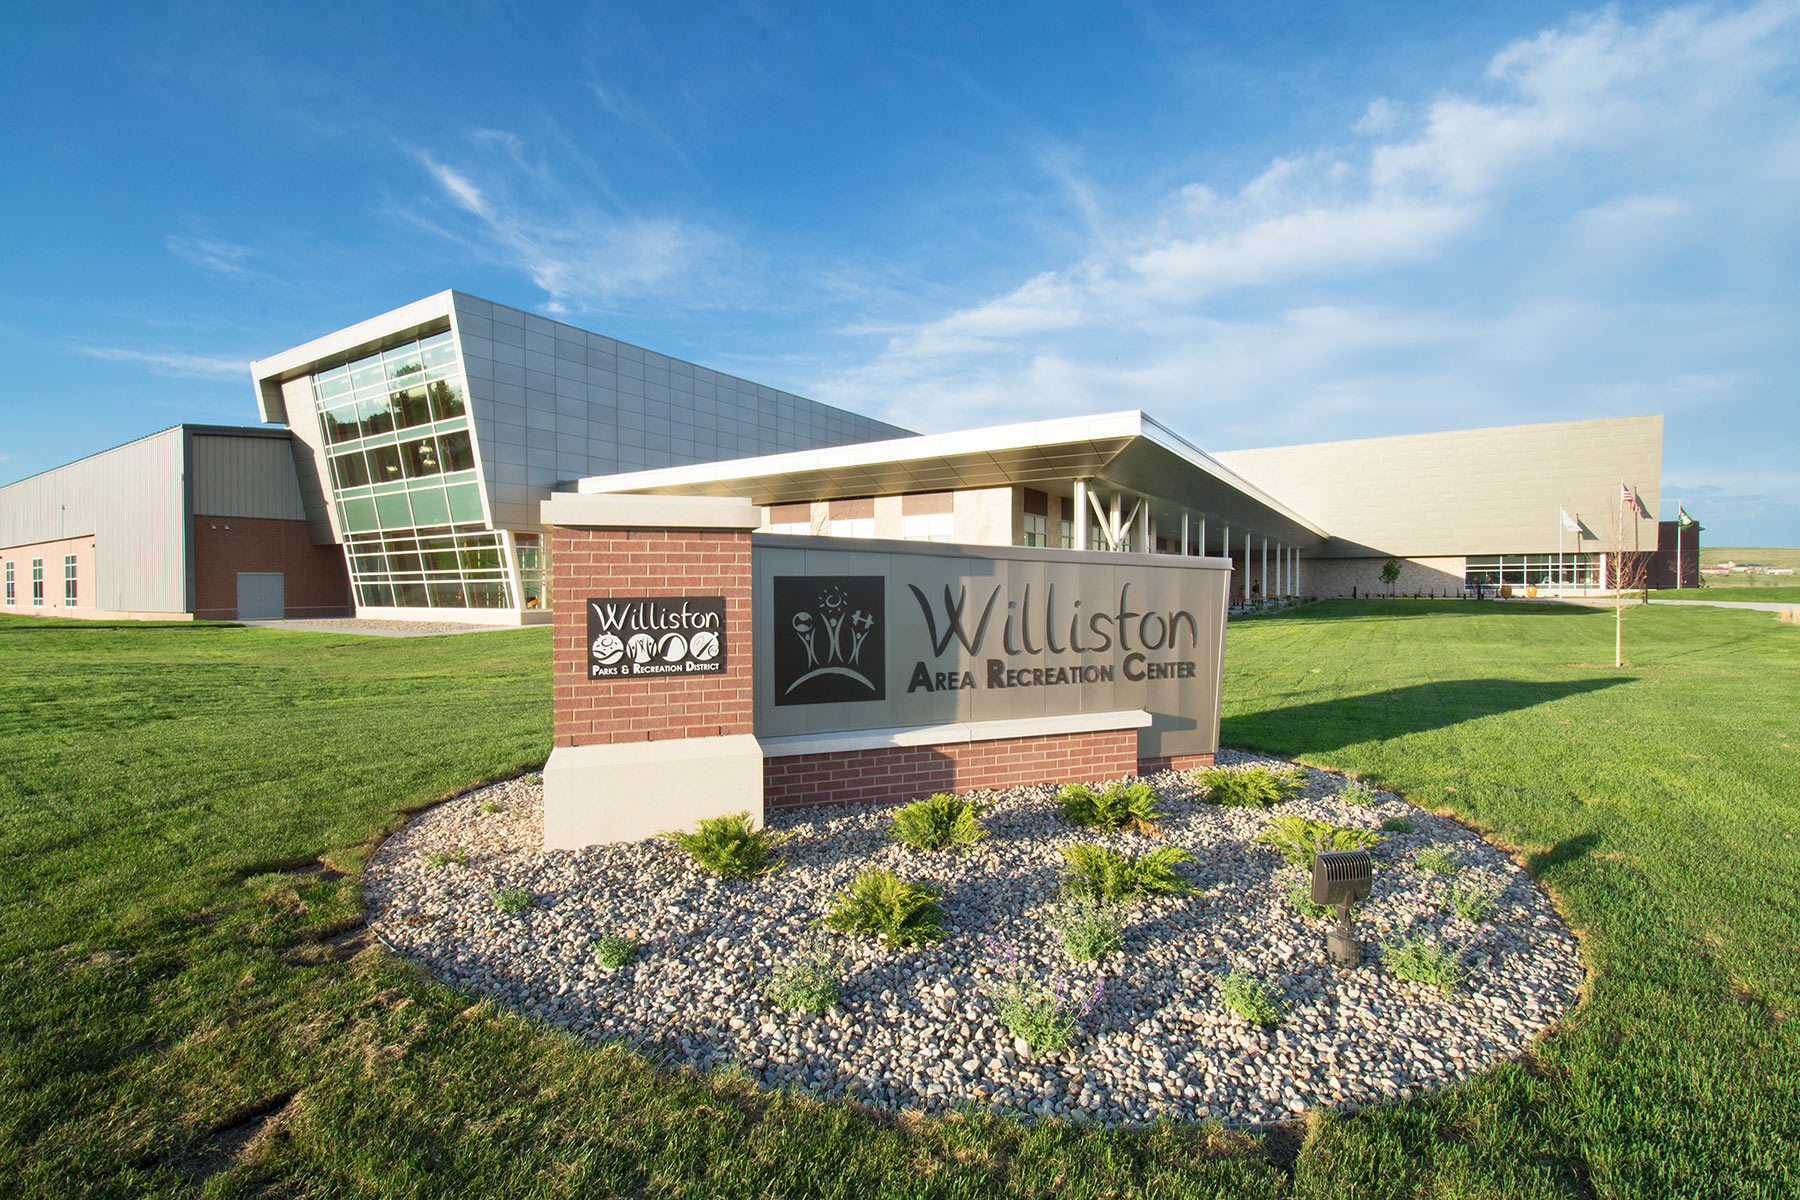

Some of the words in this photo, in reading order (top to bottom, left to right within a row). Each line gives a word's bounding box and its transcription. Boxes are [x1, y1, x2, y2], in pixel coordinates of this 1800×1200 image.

[592, 601, 720, 631] Williston
[908, 582, 1198, 657] Williston
[592, 665, 618, 676] PARKS
[621, 666, 630, 674] &
[633, 663, 682, 674] RECREATION
[686, 660, 720, 672] DISTRICT
[907, 661, 975, 693] AREA
[987, 658, 1114, 690] RECREATION
[1123, 653, 1197, 682] CENTER
